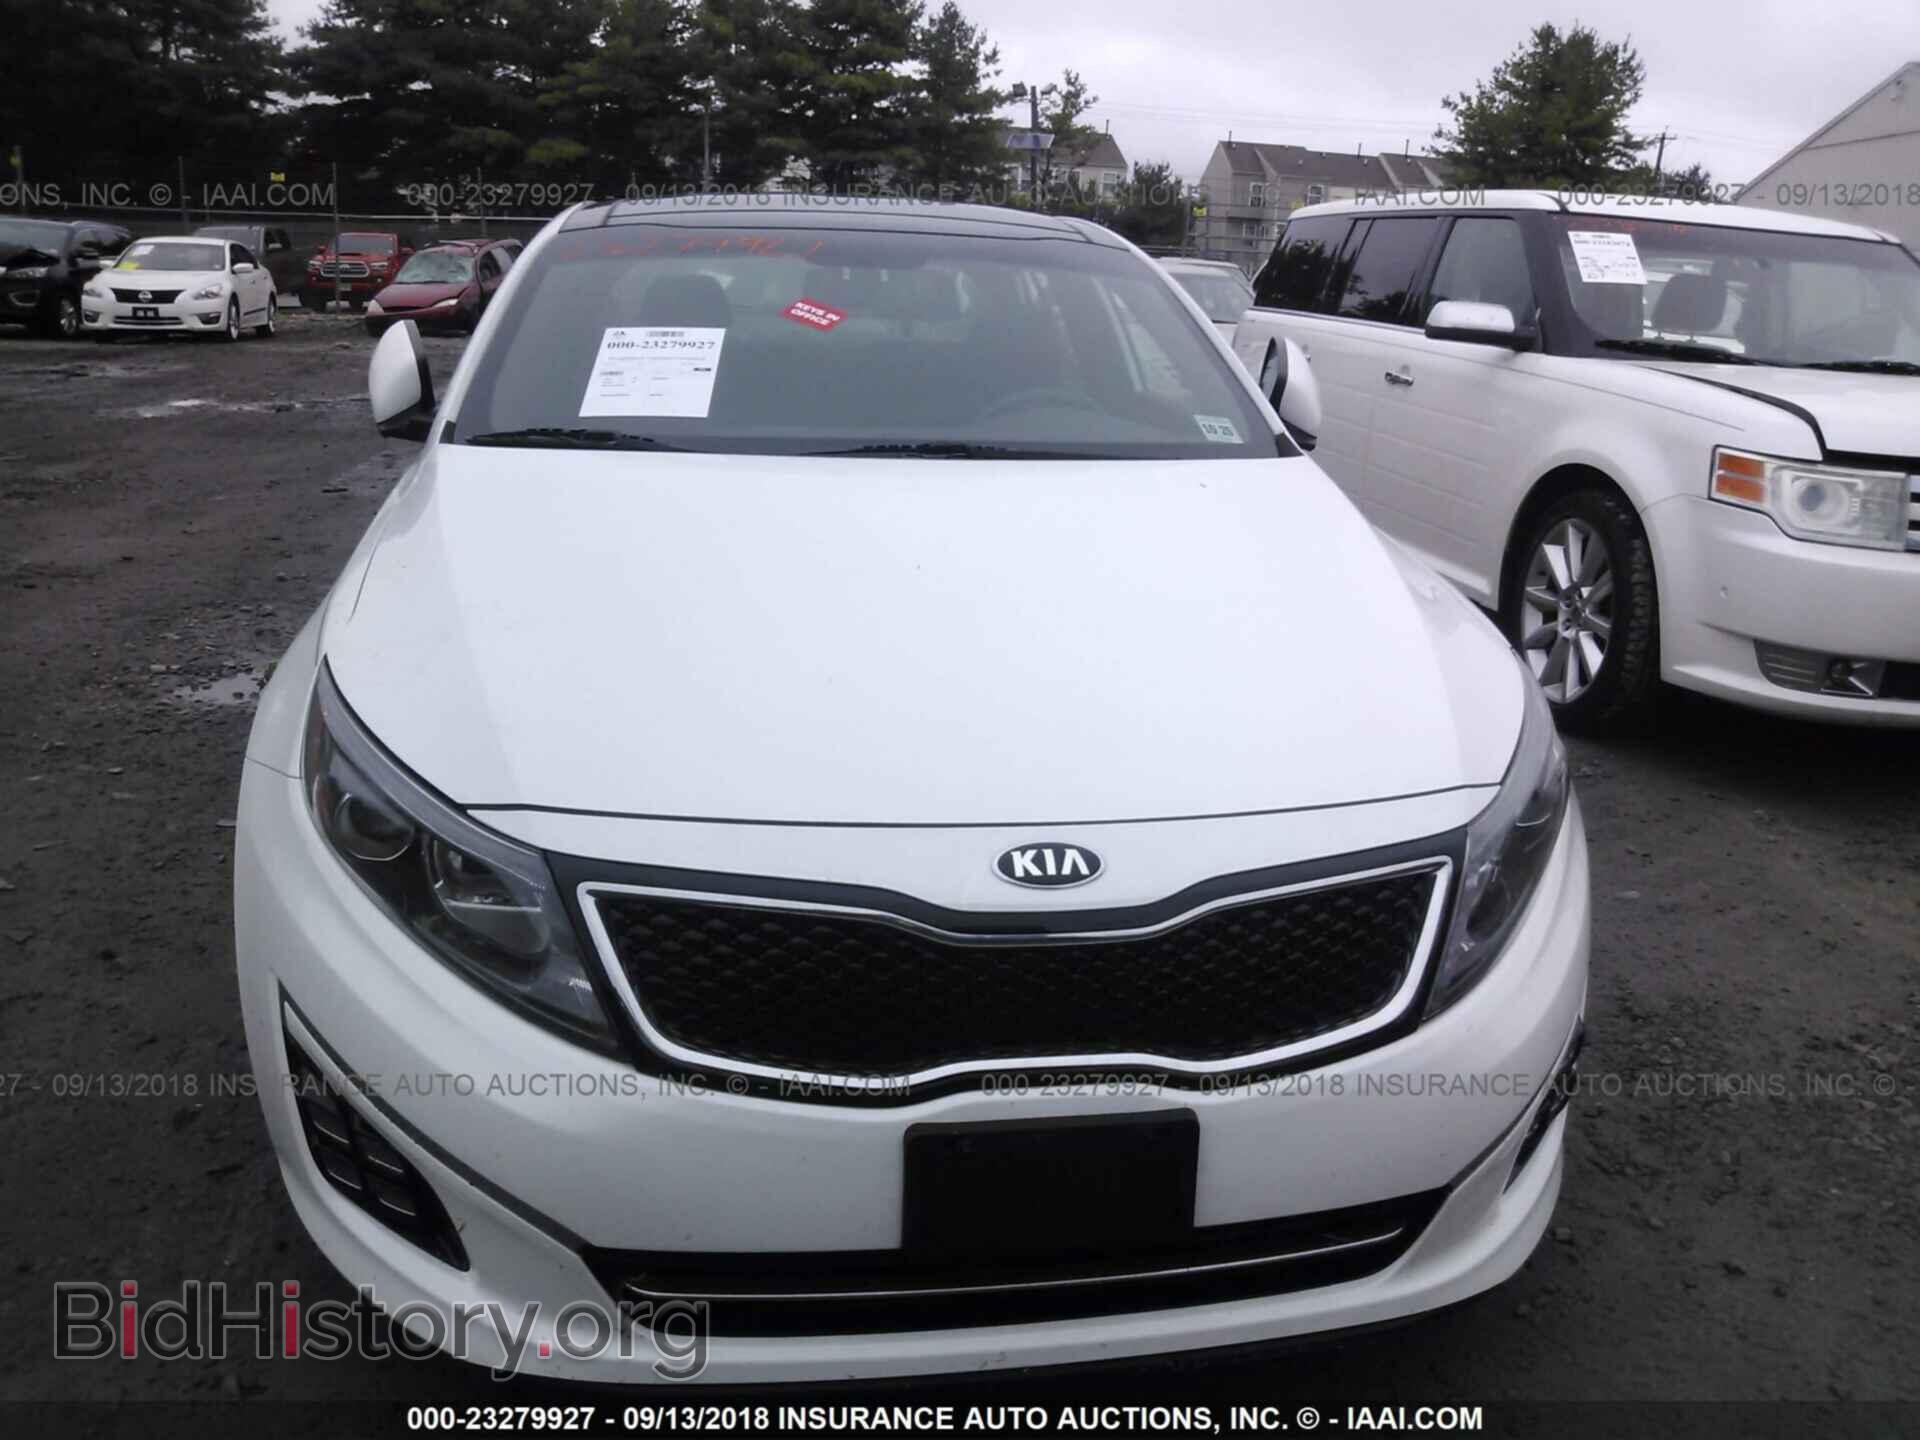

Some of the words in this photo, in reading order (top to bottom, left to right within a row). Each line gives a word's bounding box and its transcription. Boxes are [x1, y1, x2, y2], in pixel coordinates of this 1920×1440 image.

[795, 302, 826, 315] KEYS
[607, 341, 715, 349] 000-23279927
[1010, 848, 1090, 877] KIA
